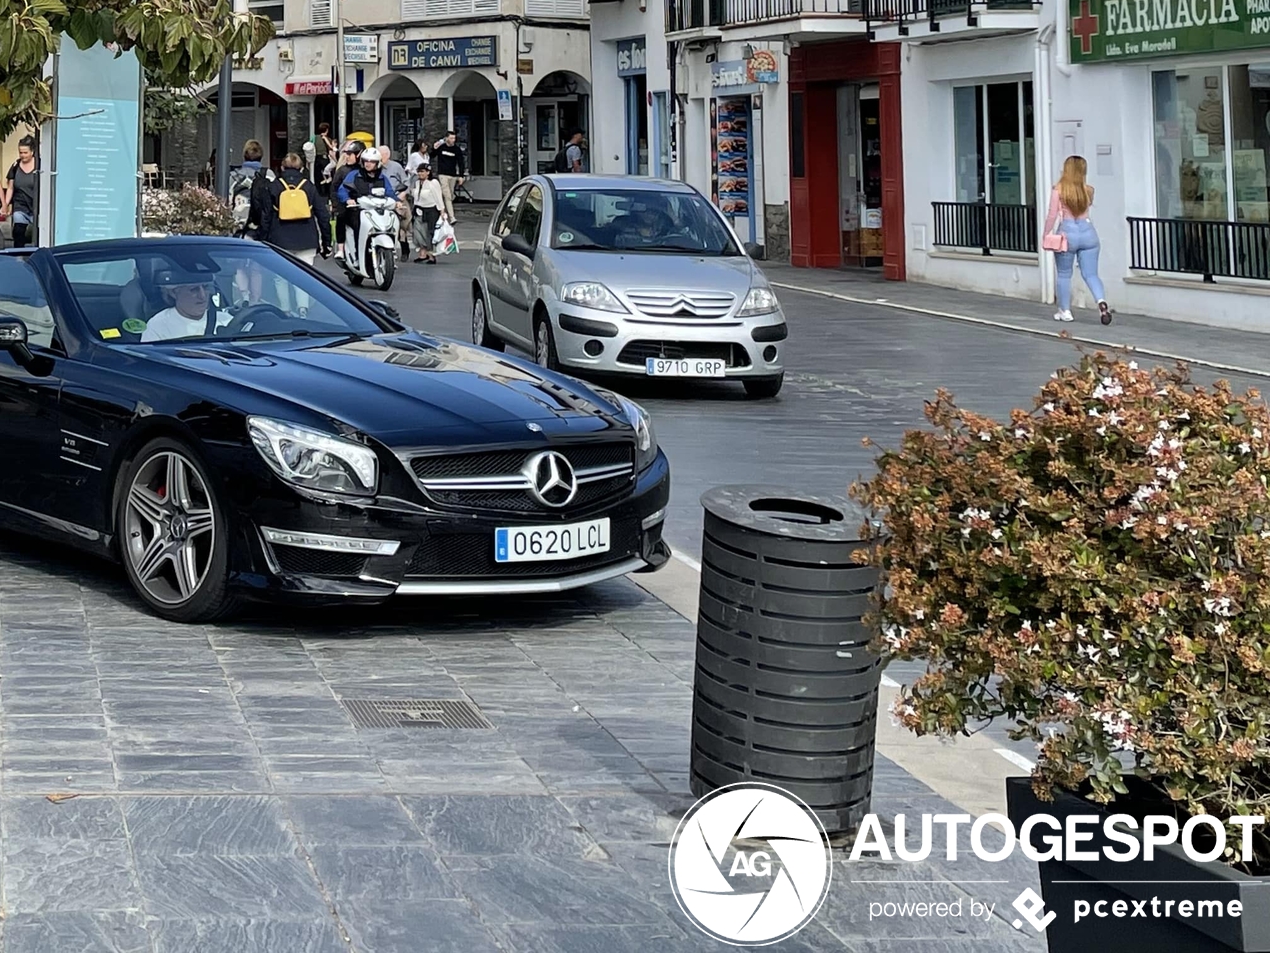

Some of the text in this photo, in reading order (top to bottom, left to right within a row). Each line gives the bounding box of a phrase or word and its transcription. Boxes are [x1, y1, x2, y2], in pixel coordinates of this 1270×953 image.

[416, 41, 456, 53] OFICINA
[470, 38, 492, 47] CHANGE
[412, 56, 461, 67] DE CANVI
[656, 360, 689, 374] 9710
[695, 361, 722, 374] GRP
[514, 523, 607, 556] 0620 LCL
